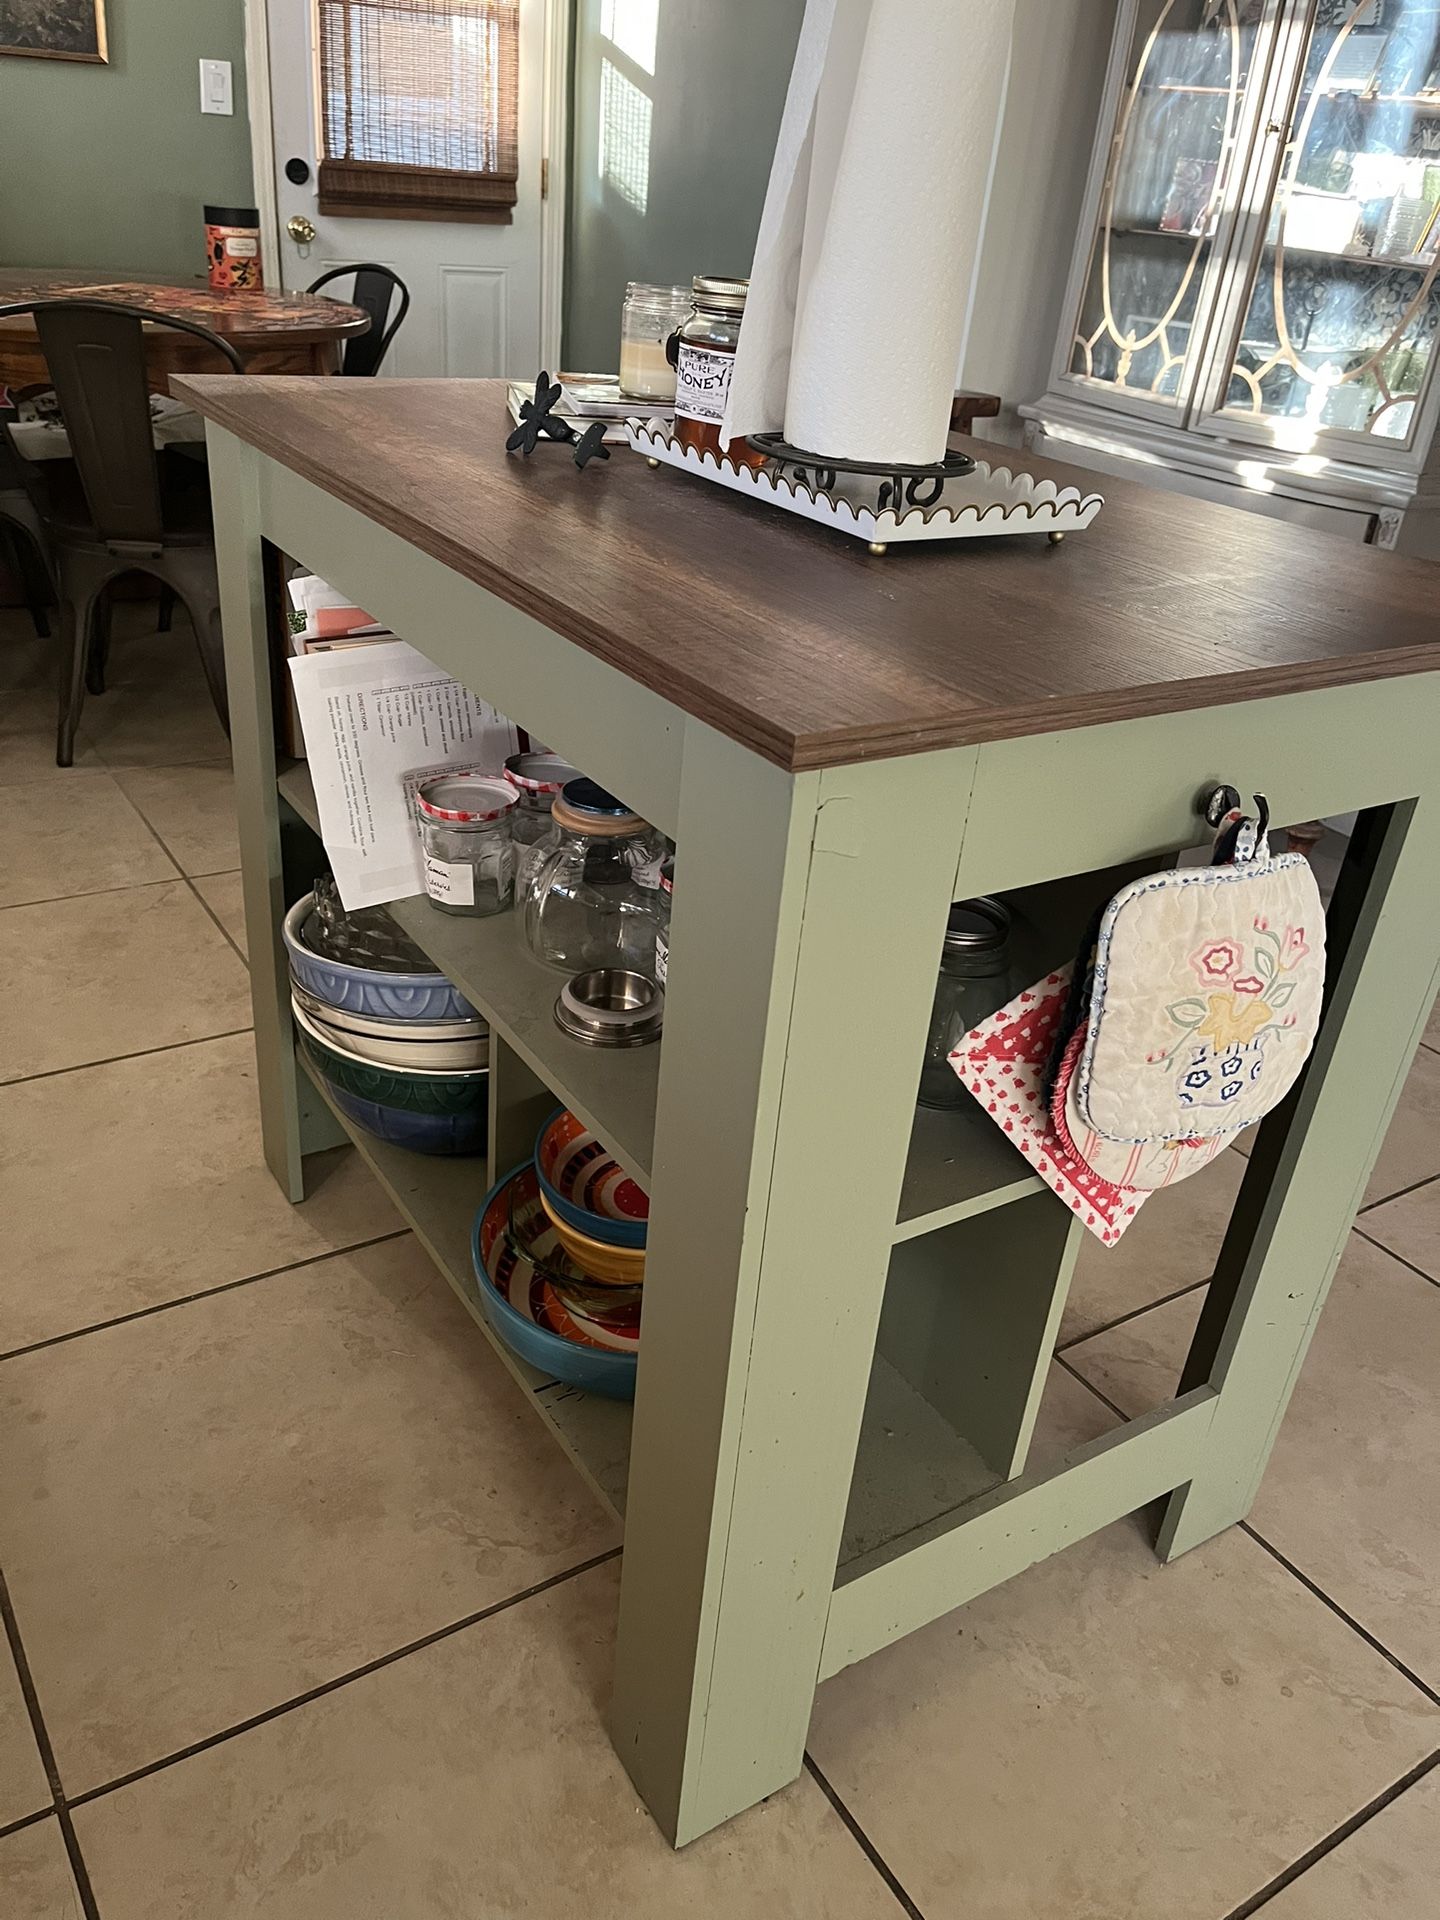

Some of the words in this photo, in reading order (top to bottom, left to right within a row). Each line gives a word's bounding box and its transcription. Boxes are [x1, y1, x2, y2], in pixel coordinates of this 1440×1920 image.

[679, 358, 727, 389] HONEY
[685, 361, 715, 374] PURE
[357, 692, 368, 731] DIRECTIONS
